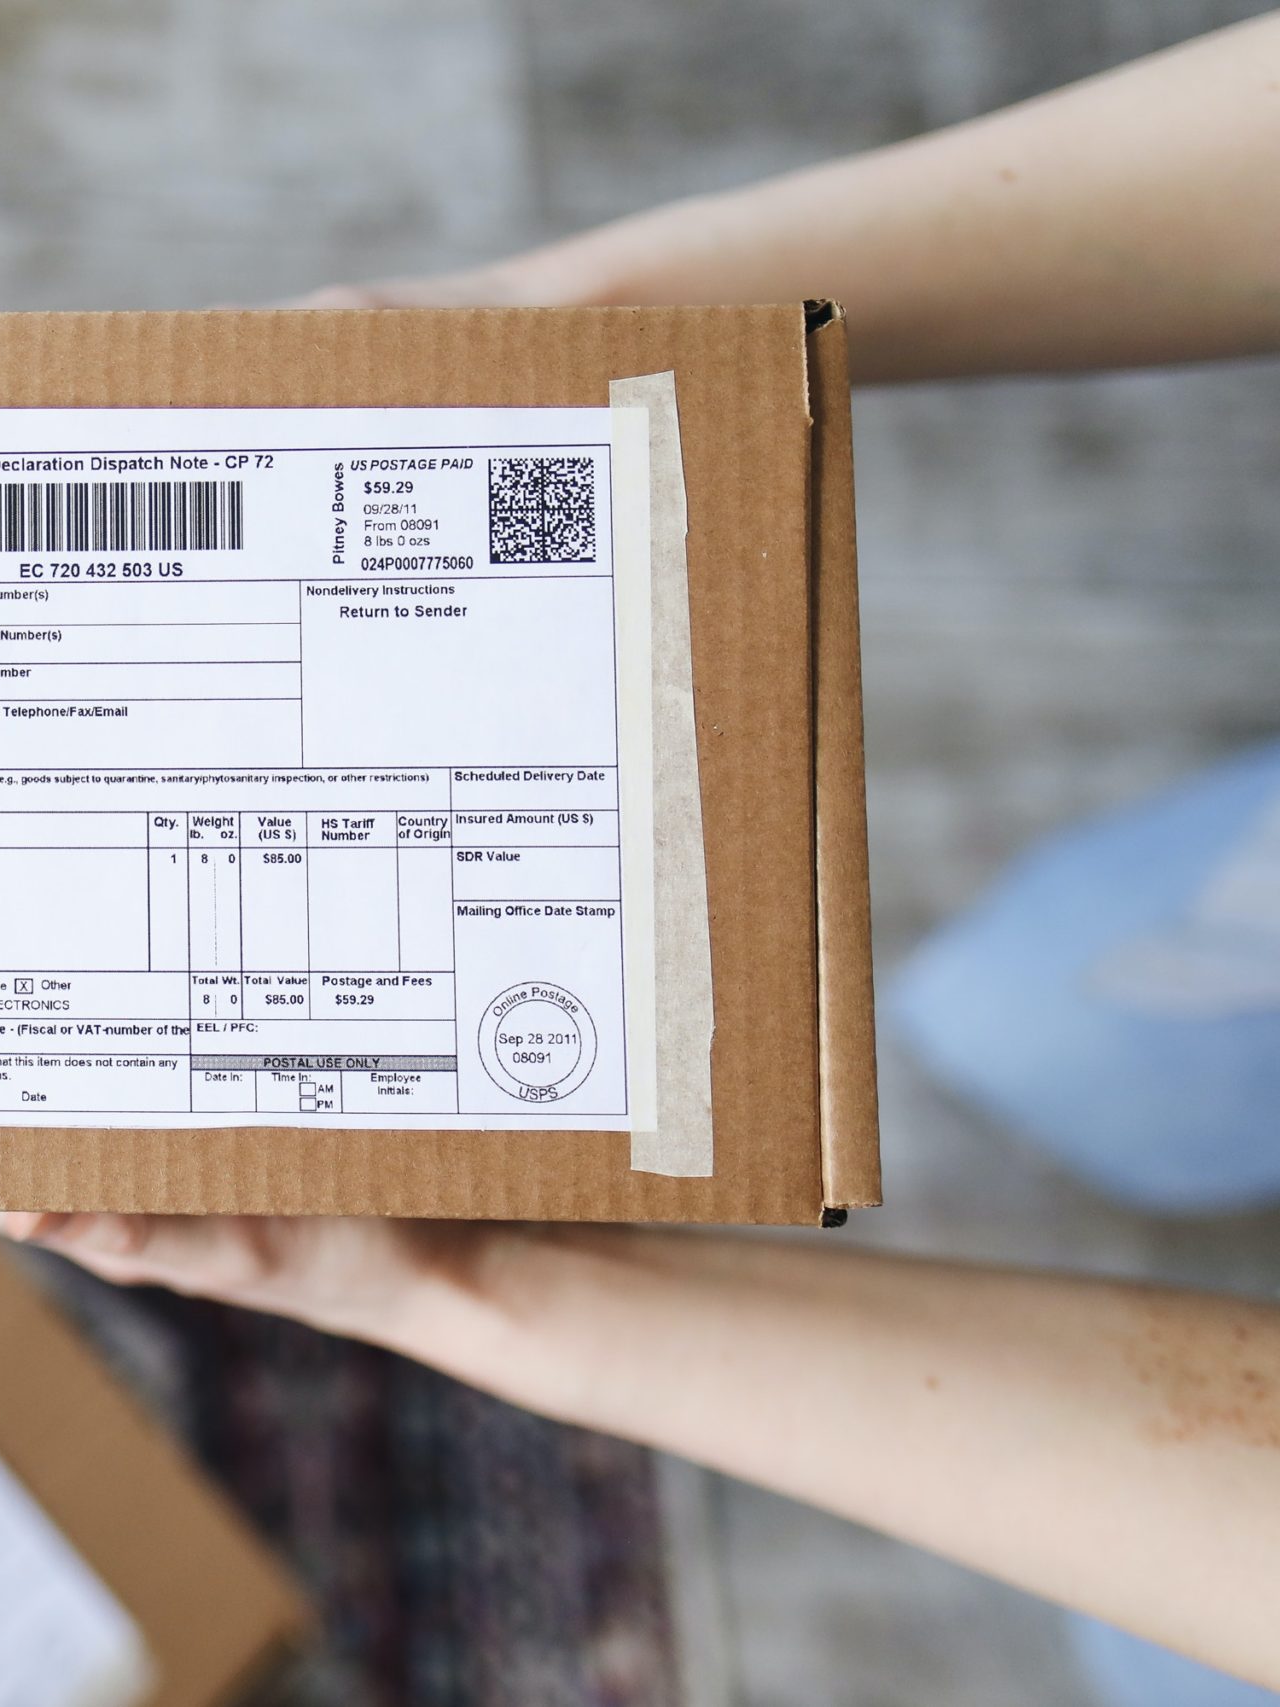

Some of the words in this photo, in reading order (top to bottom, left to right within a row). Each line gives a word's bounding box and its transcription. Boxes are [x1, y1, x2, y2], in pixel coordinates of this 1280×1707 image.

[90, 455, 163, 474] Dispatch
[170, 455, 208, 469] Note
[225, 455, 249, 469] CP
[254, 454, 274, 468] 72
[350, 459, 367, 471] US
[369, 458, 437, 471] POSTAGE
[440, 457, 473, 469] PAID
[332, 462, 344, 512] Bowes
[363, 480, 413, 495] $59.29
[363, 503, 416, 515] 09/28/11
[364, 519, 396, 531] From
[400, 518, 438, 531] 08091
[332, 517, 347, 564] Pitney
[363, 535, 372, 547] 8
[375, 535, 393, 546] lbs
[397, 534, 405, 546] 0
[408, 537, 430, 546] ozs
[360, 555, 474, 571] 024P0007775060
[19, 563, 43, 578] EC
[49, 563, 80, 578] 720
[85, 562, 116, 578] 432
[122, 562, 152, 577] 503
[158, 562, 183, 577] US
[306, 585, 379, 598] Nondelivery
[382, 583, 455, 595] Instructions
[339, 605, 389, 618] Return
[393, 605, 409, 618] to
[414, 605, 467, 617] Sender
[0, 629, 62, 642] Number(s)
[2, 705, 128, 719] Telephone/Fax/Email
[453, 770, 520, 781] Scheduled
[523, 770, 574, 783] Delivery
[577, 770, 605, 781] Date
[153, 815, 179, 830] Qty.
[192, 815, 234, 829] Weight
[257, 816, 292, 827] Value
[321, 818, 338, 829] HS
[341, 817, 375, 829] Tariff
[397, 815, 448, 830] Country
[455, 813, 503, 824] Insured
[505, 813, 554, 824] Amount
[557, 813, 579, 826] (US
[321, 830, 370, 841] Number
[262, 852, 302, 864] $85.00
[456, 851, 483, 862] SDR
[486, 851, 520, 861] Value
[456, 905, 501, 919] Mailing
[504, 905, 541, 916] Office
[544, 905, 572, 916] Date
[575, 905, 615, 918] Stamp
[41, 979, 71, 990] Other
[191, 975, 218, 985] Total
[221, 975, 240, 985] Wt.
[243, 975, 271, 985] Total
[276, 975, 307, 985] Value
[321, 975, 372, 989] Postage
[375, 975, 399, 986] and
[401, 975, 432, 986] Fees
[265, 993, 304, 1005] $85.00
[335, 993, 374, 1005] $59.29
[493, 990, 528, 1017] Online
[531, 986, 579, 1014] Postage
[17, 1023, 56, 1036] (Fiscal
[59, 1026, 73, 1035] or
[75, 1024, 153, 1035] VAT-number
[155, 1024, 168, 1035] of
[497, 1032, 523, 1047] Sep
[527, 1032, 544, 1044] 28
[547, 1033, 576, 1044] 2011
[263, 1057, 314, 1068] POSTAL
[316, 1056, 342, 1068] USE
[345, 1057, 380, 1068] ONLY
[512, 1051, 551, 1063] 08091
[21, 1090, 47, 1102] Date
[518, 1086, 558, 1101] USPS
